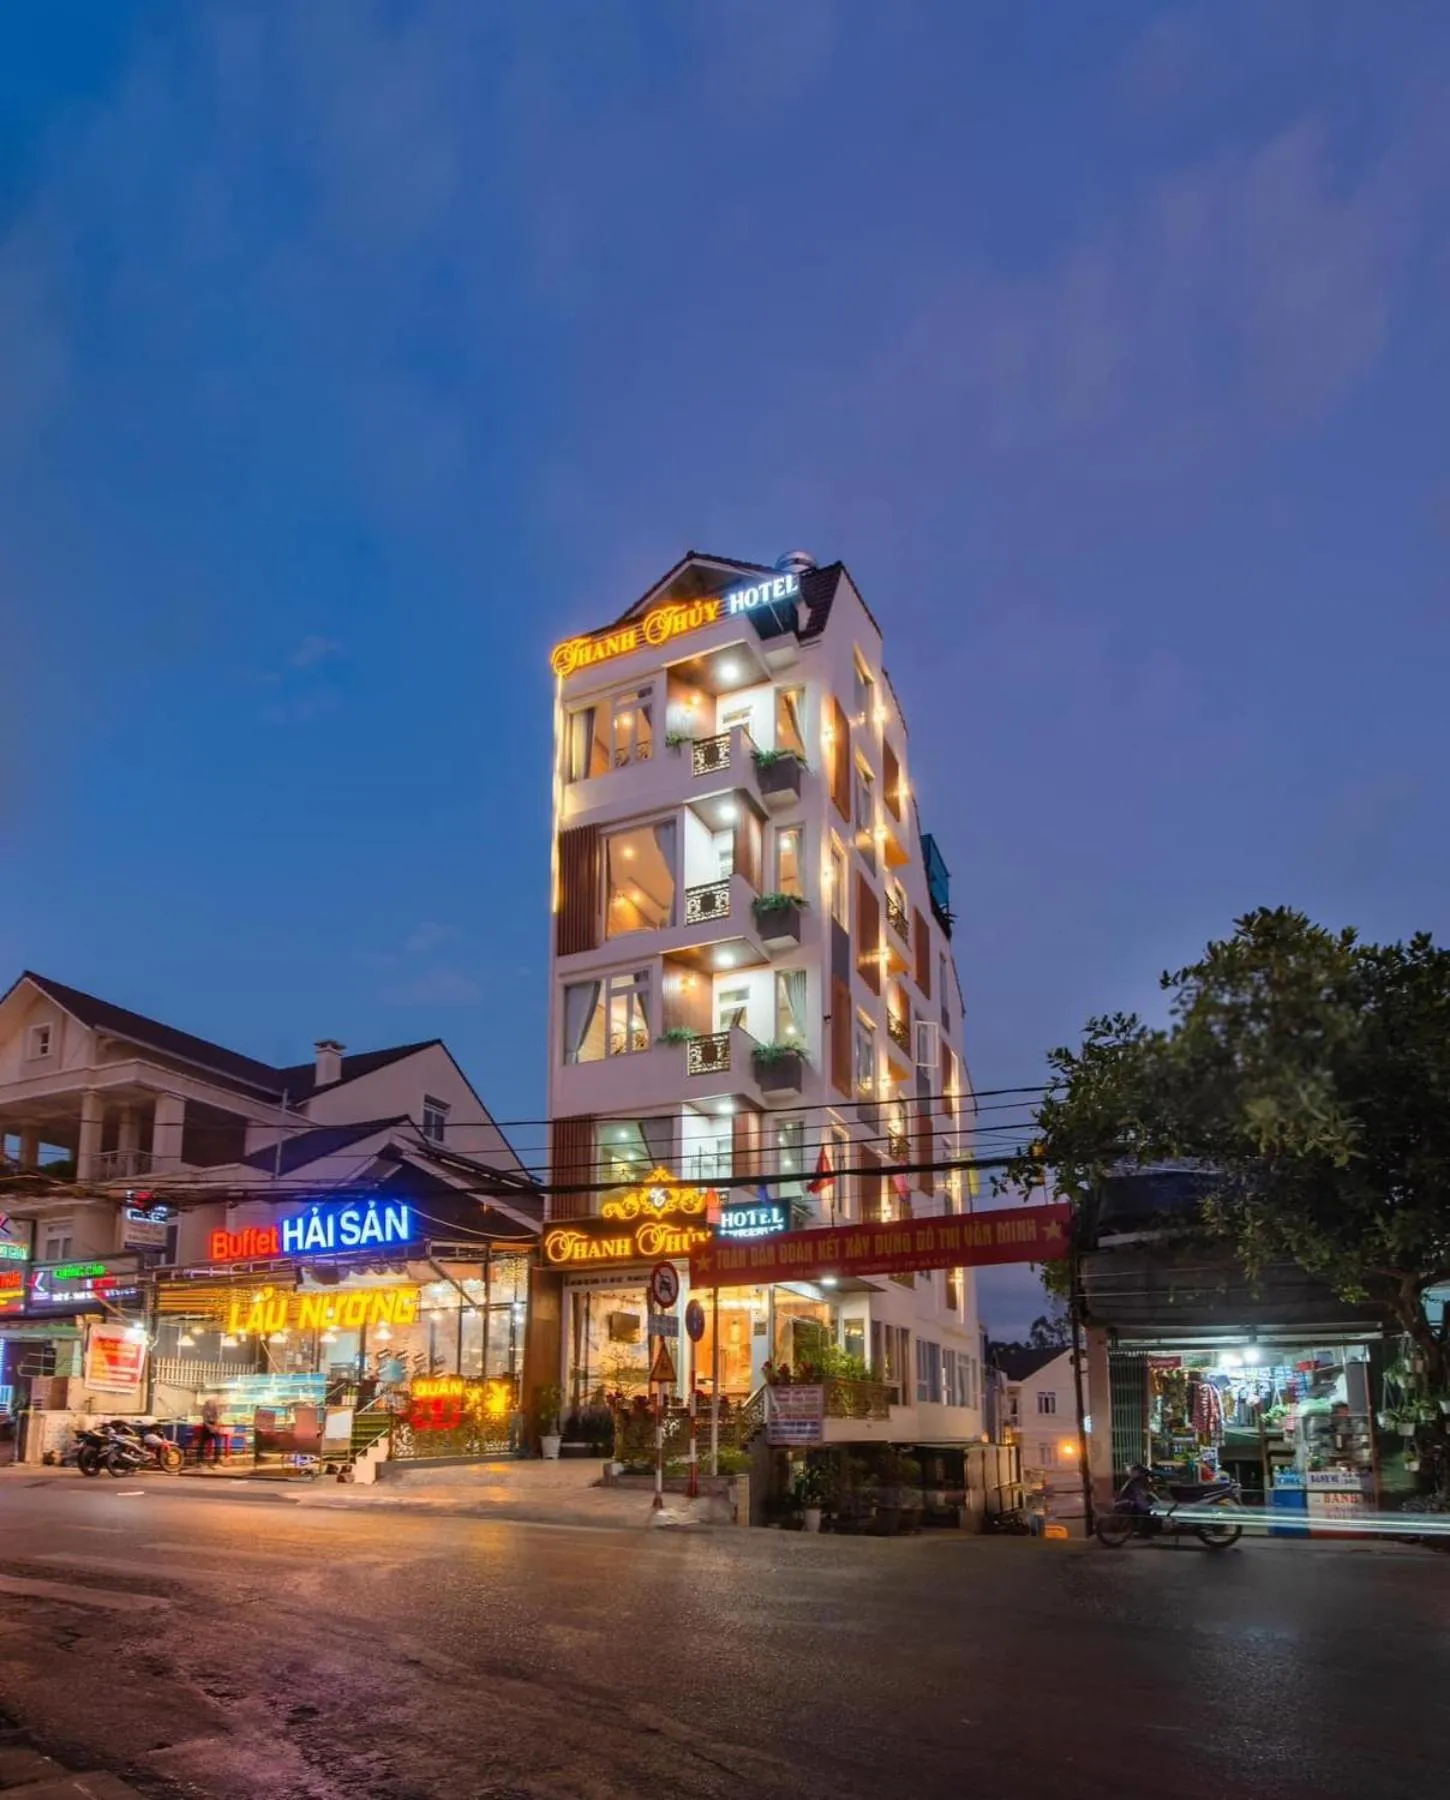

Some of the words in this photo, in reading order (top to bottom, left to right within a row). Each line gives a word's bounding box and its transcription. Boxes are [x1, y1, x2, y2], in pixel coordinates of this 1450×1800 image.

[551, 629, 637, 676] THANH
[729, 574, 798, 613] HOTEL
[212, 1227, 279, 1259] Buffet
[283, 1207, 335, 1251] HẢI
[340, 1201, 409, 1245] SẢN
[720, 1207, 784, 1228] HOTEL
[997, 1219, 1037, 1244] MINH
[545, 1230, 632, 1262] THANH
